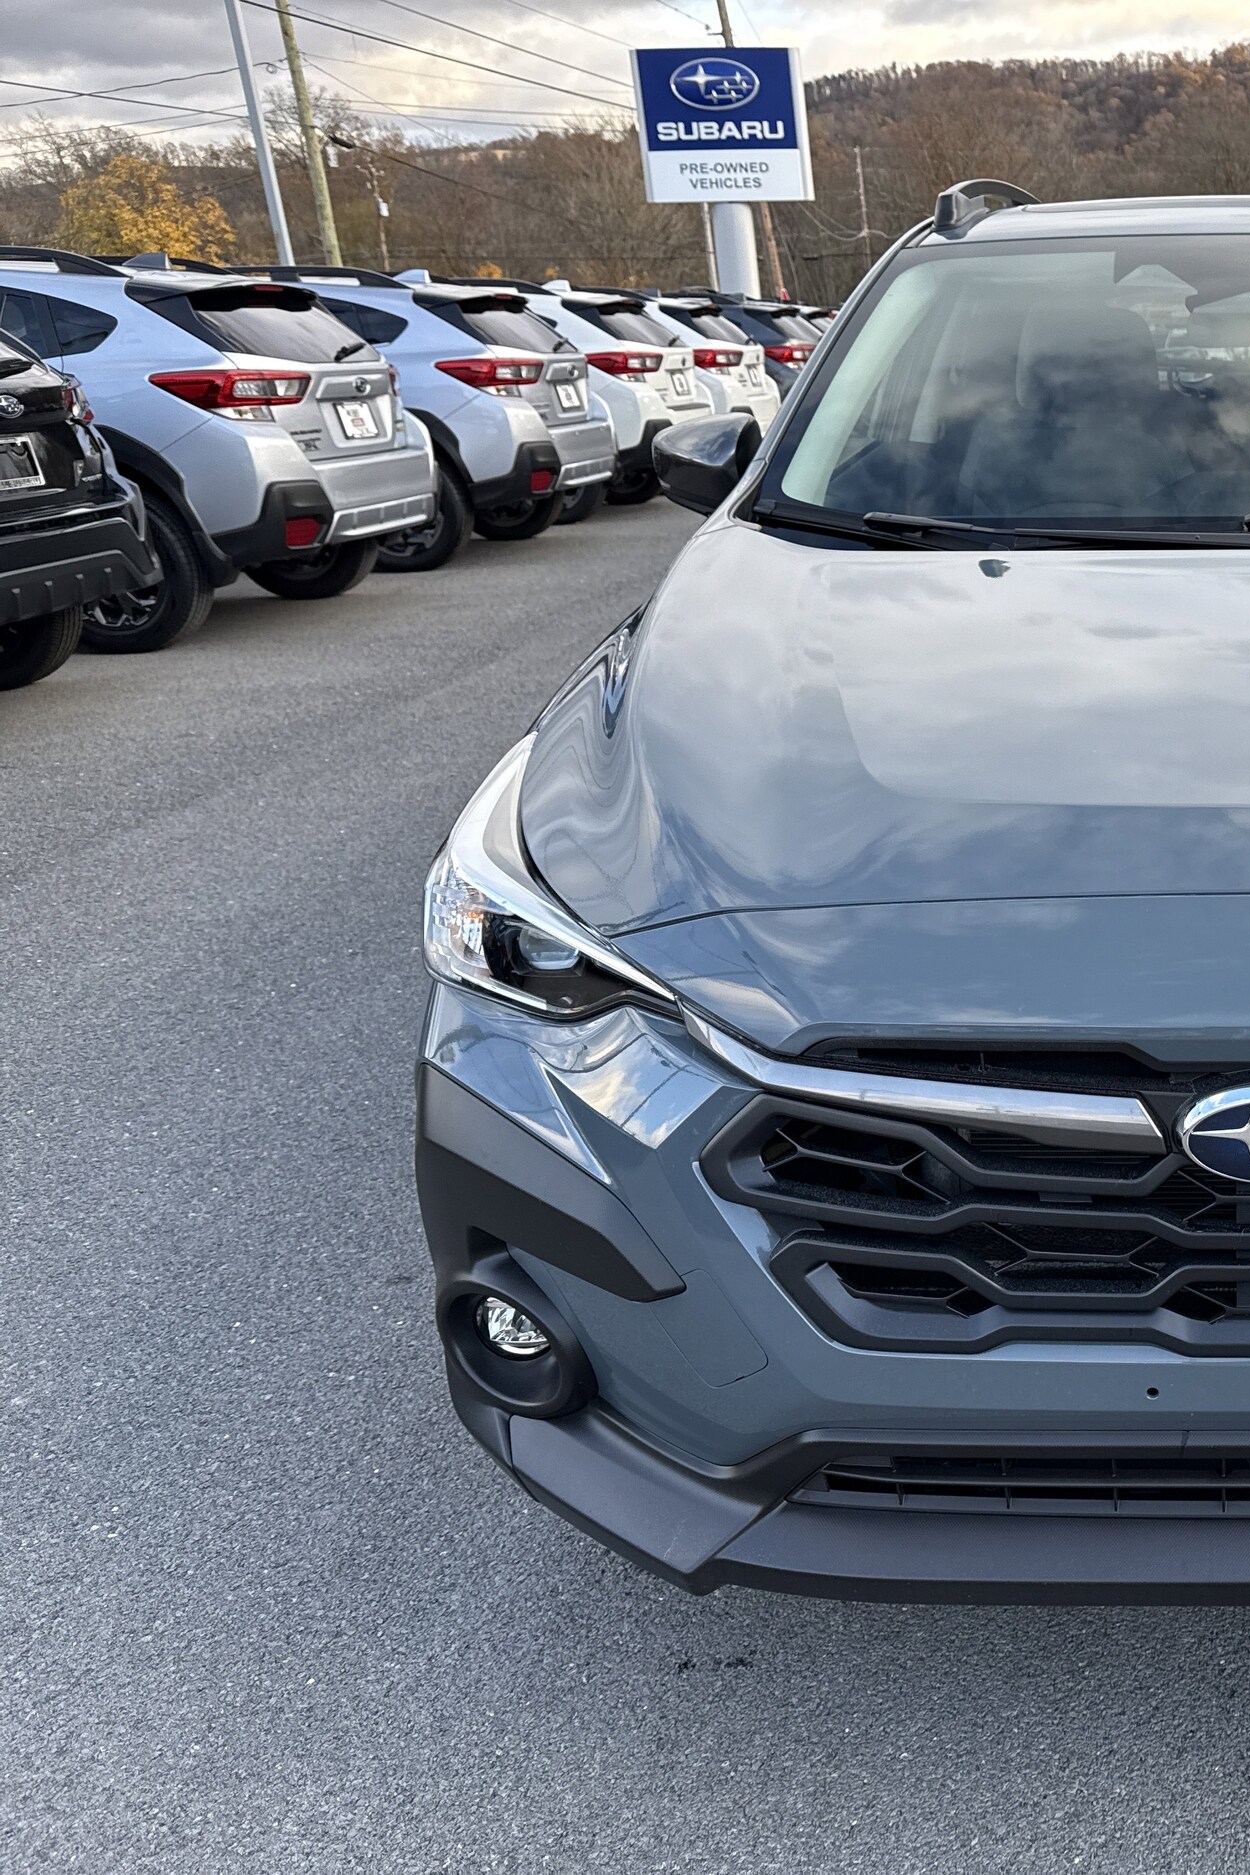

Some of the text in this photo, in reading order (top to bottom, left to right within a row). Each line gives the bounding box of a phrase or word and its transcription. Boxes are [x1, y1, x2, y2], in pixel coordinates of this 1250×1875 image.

[656, 120, 785, 141] SUBARU
[679, 162, 769, 175] PRE-OWNED
[689, 177, 762, 189] VEHICLES
